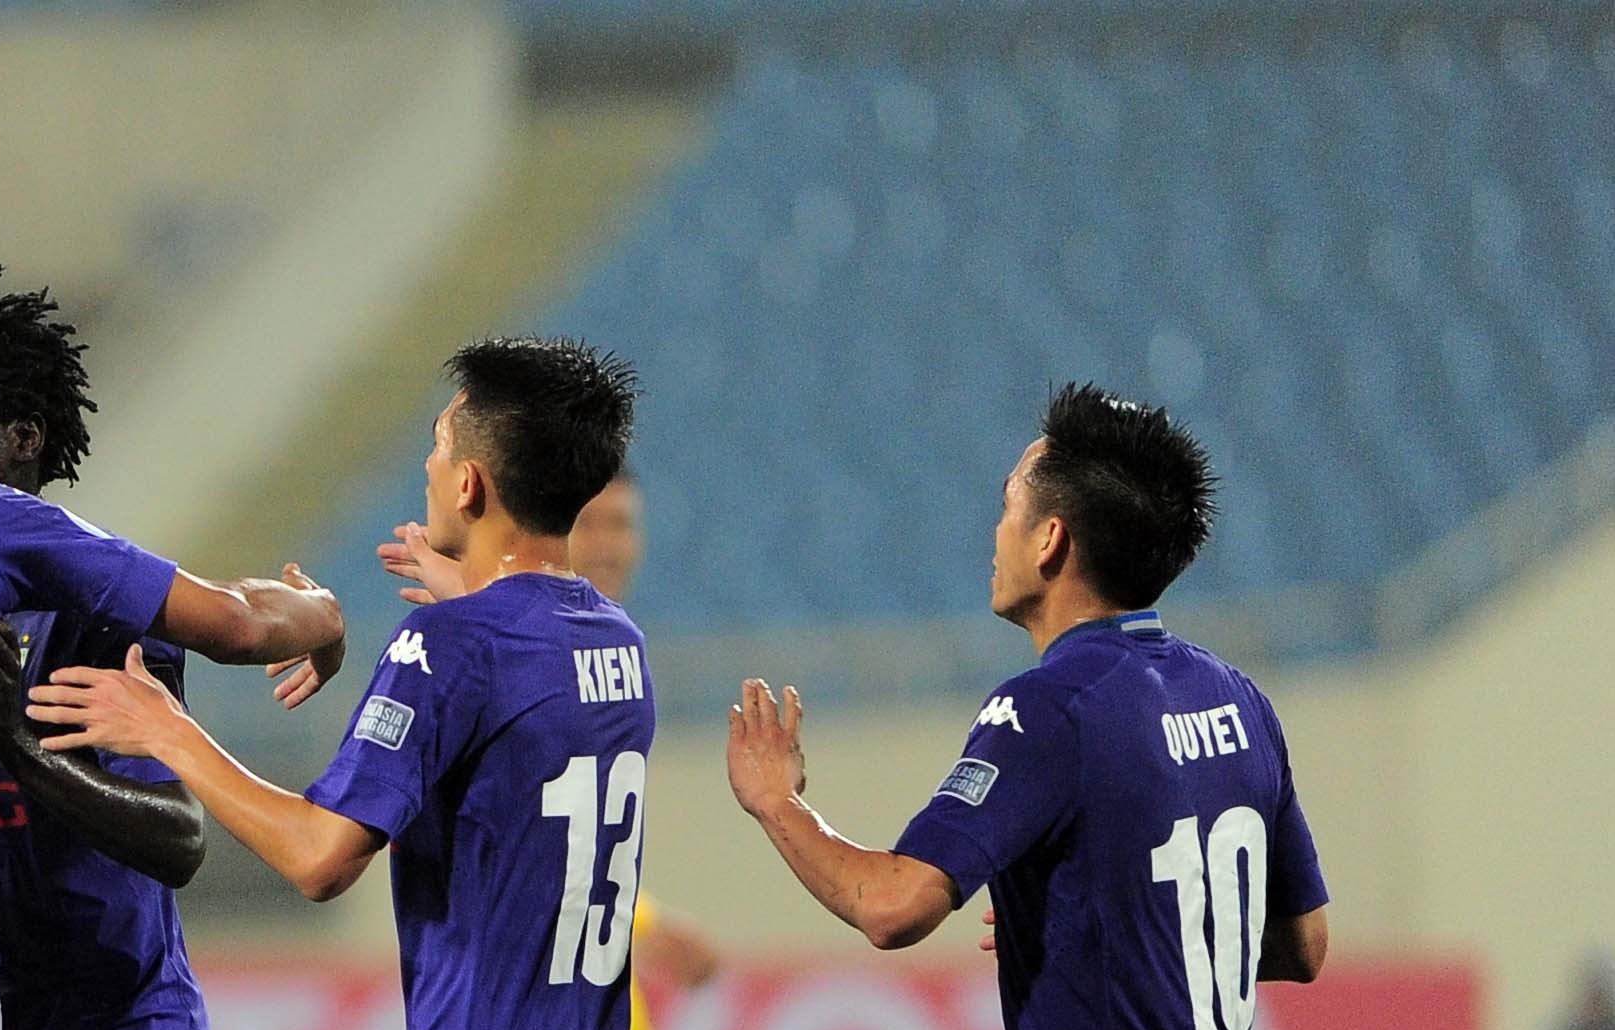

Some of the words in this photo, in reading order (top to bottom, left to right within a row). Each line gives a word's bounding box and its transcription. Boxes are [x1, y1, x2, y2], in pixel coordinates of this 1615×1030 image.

[573, 645, 644, 704] KIEN
[1161, 703, 1250, 766] QUYET
[542, 751, 646, 986] 13
